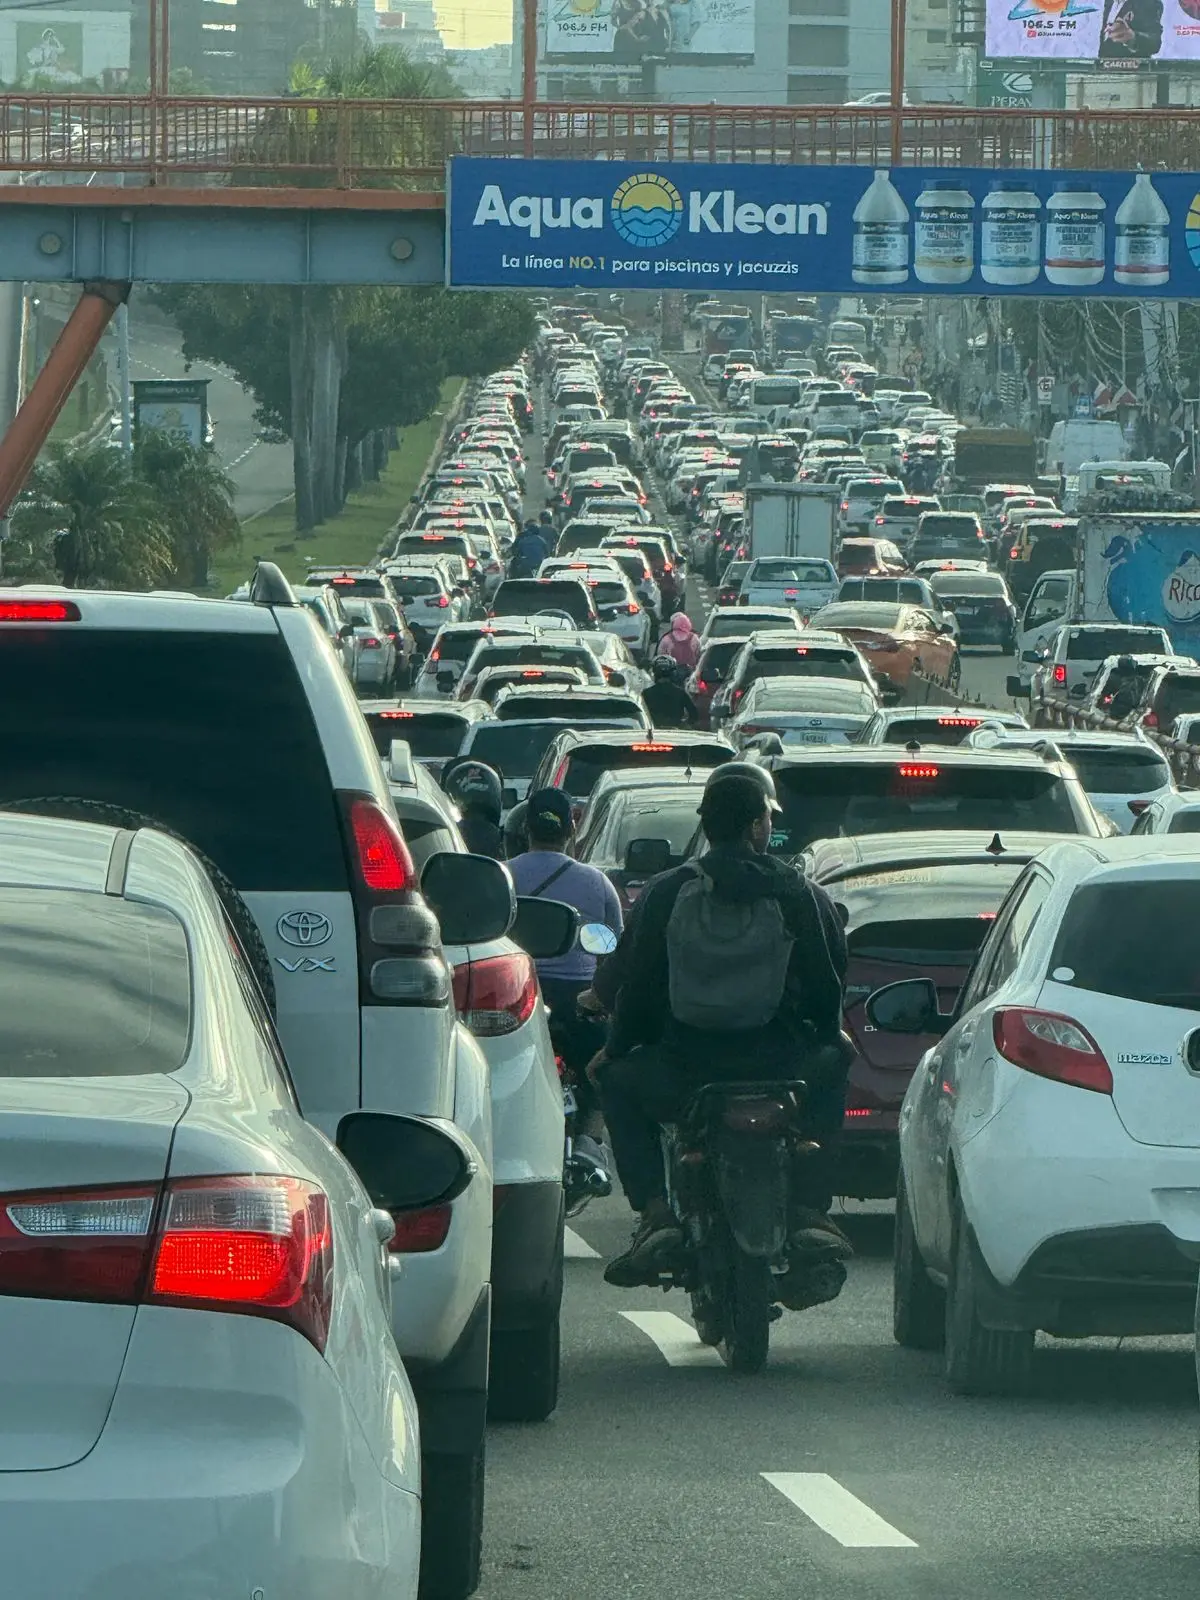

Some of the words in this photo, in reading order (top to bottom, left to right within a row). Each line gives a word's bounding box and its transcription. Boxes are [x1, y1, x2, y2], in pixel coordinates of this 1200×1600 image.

[590, 22, 608, 31] FM
[1022, 20, 1054, 29] 106.5
[1058, 20, 1077, 30] FM
[472, 184, 604, 238] Aqua
[688, 189, 829, 236] Klean
[502, 254, 520, 268] La
[525, 254, 564, 269] línea
[569, 256, 605, 270] NO.1
[612, 259, 650, 274] para
[654, 259, 720, 275] piscinas
[725, 263, 734, 276] y
[738, 261, 799, 276] jacuzzis
[274, 956, 337, 972] VX
[1117, 1053, 1172, 1064] mazda
